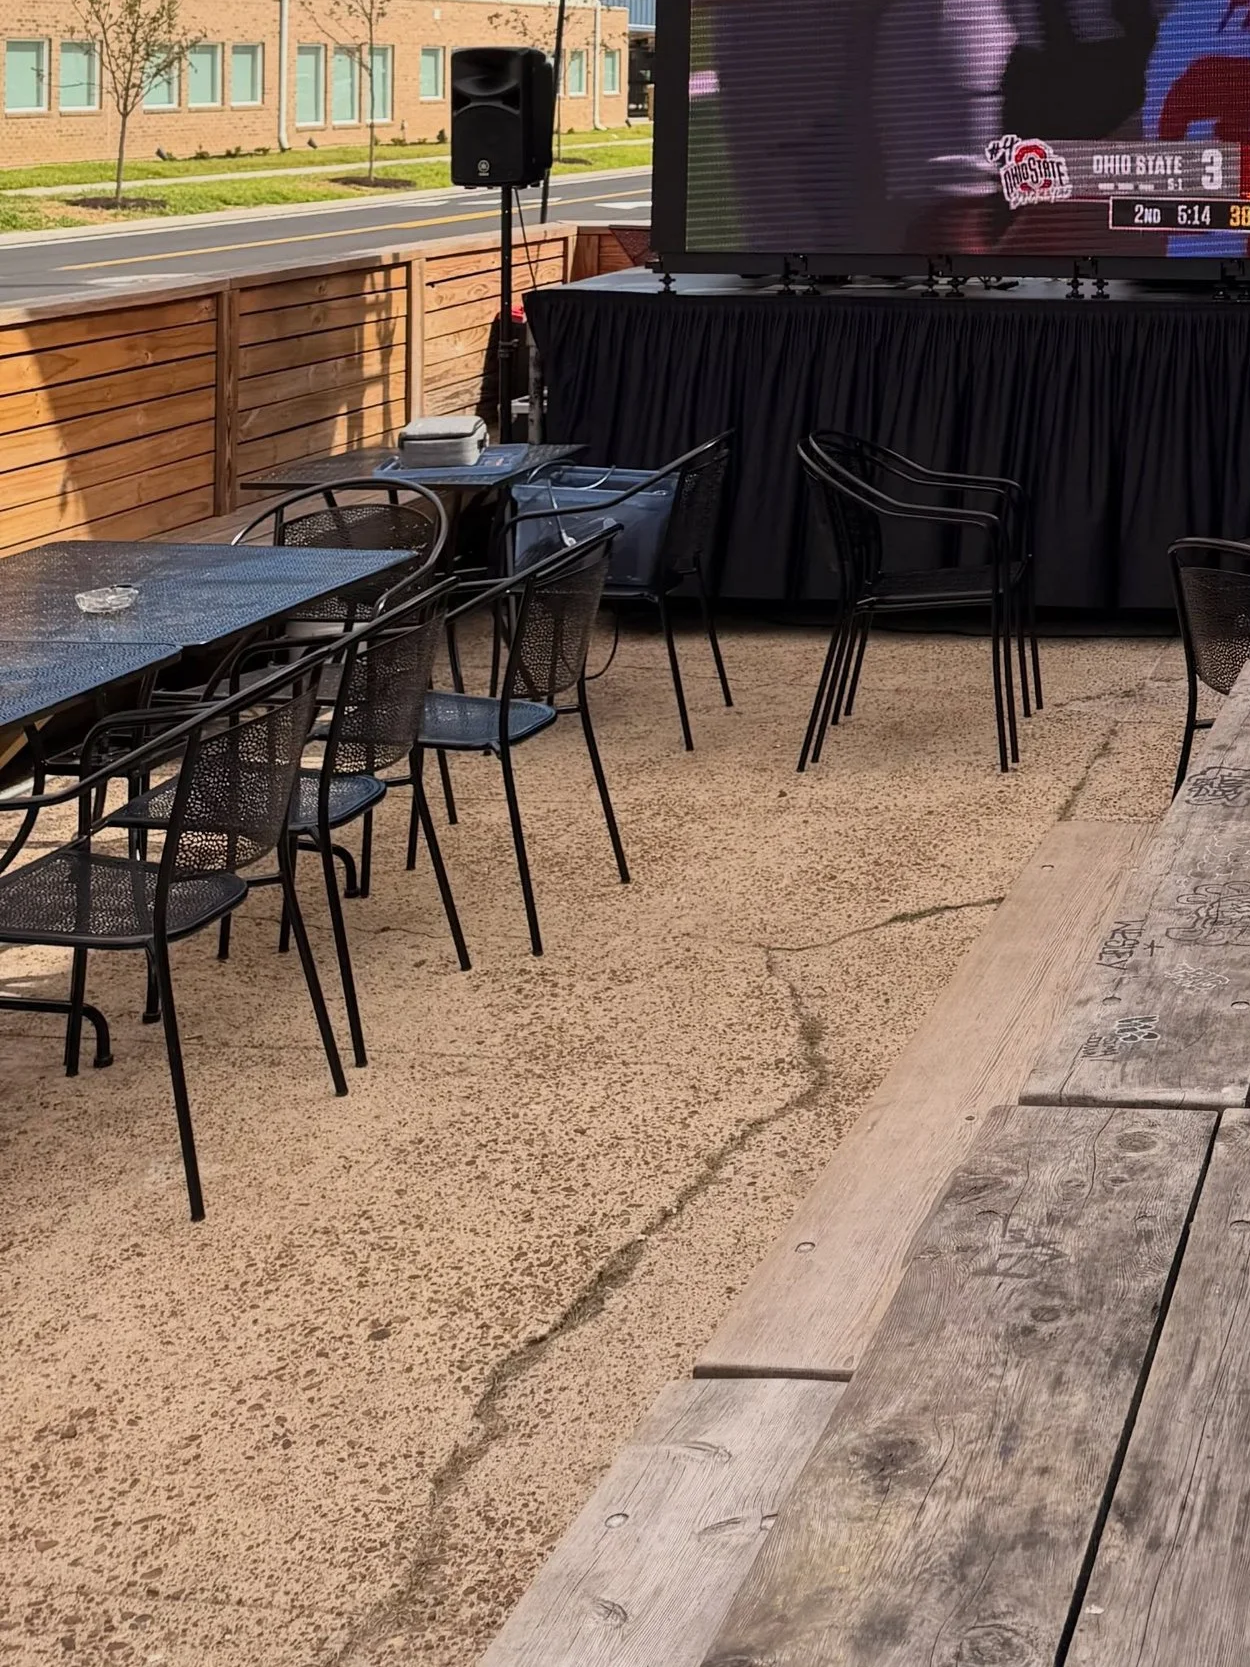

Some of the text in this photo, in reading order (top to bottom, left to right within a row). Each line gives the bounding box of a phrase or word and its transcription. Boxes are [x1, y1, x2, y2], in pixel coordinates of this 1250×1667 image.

[987, 135, 1017, 163] #4
[1092, 148, 1223, 191] OHIO STATE 3
[1133, 204, 1161, 224] 2ND
[1176, 205, 1211, 226] 5:14
